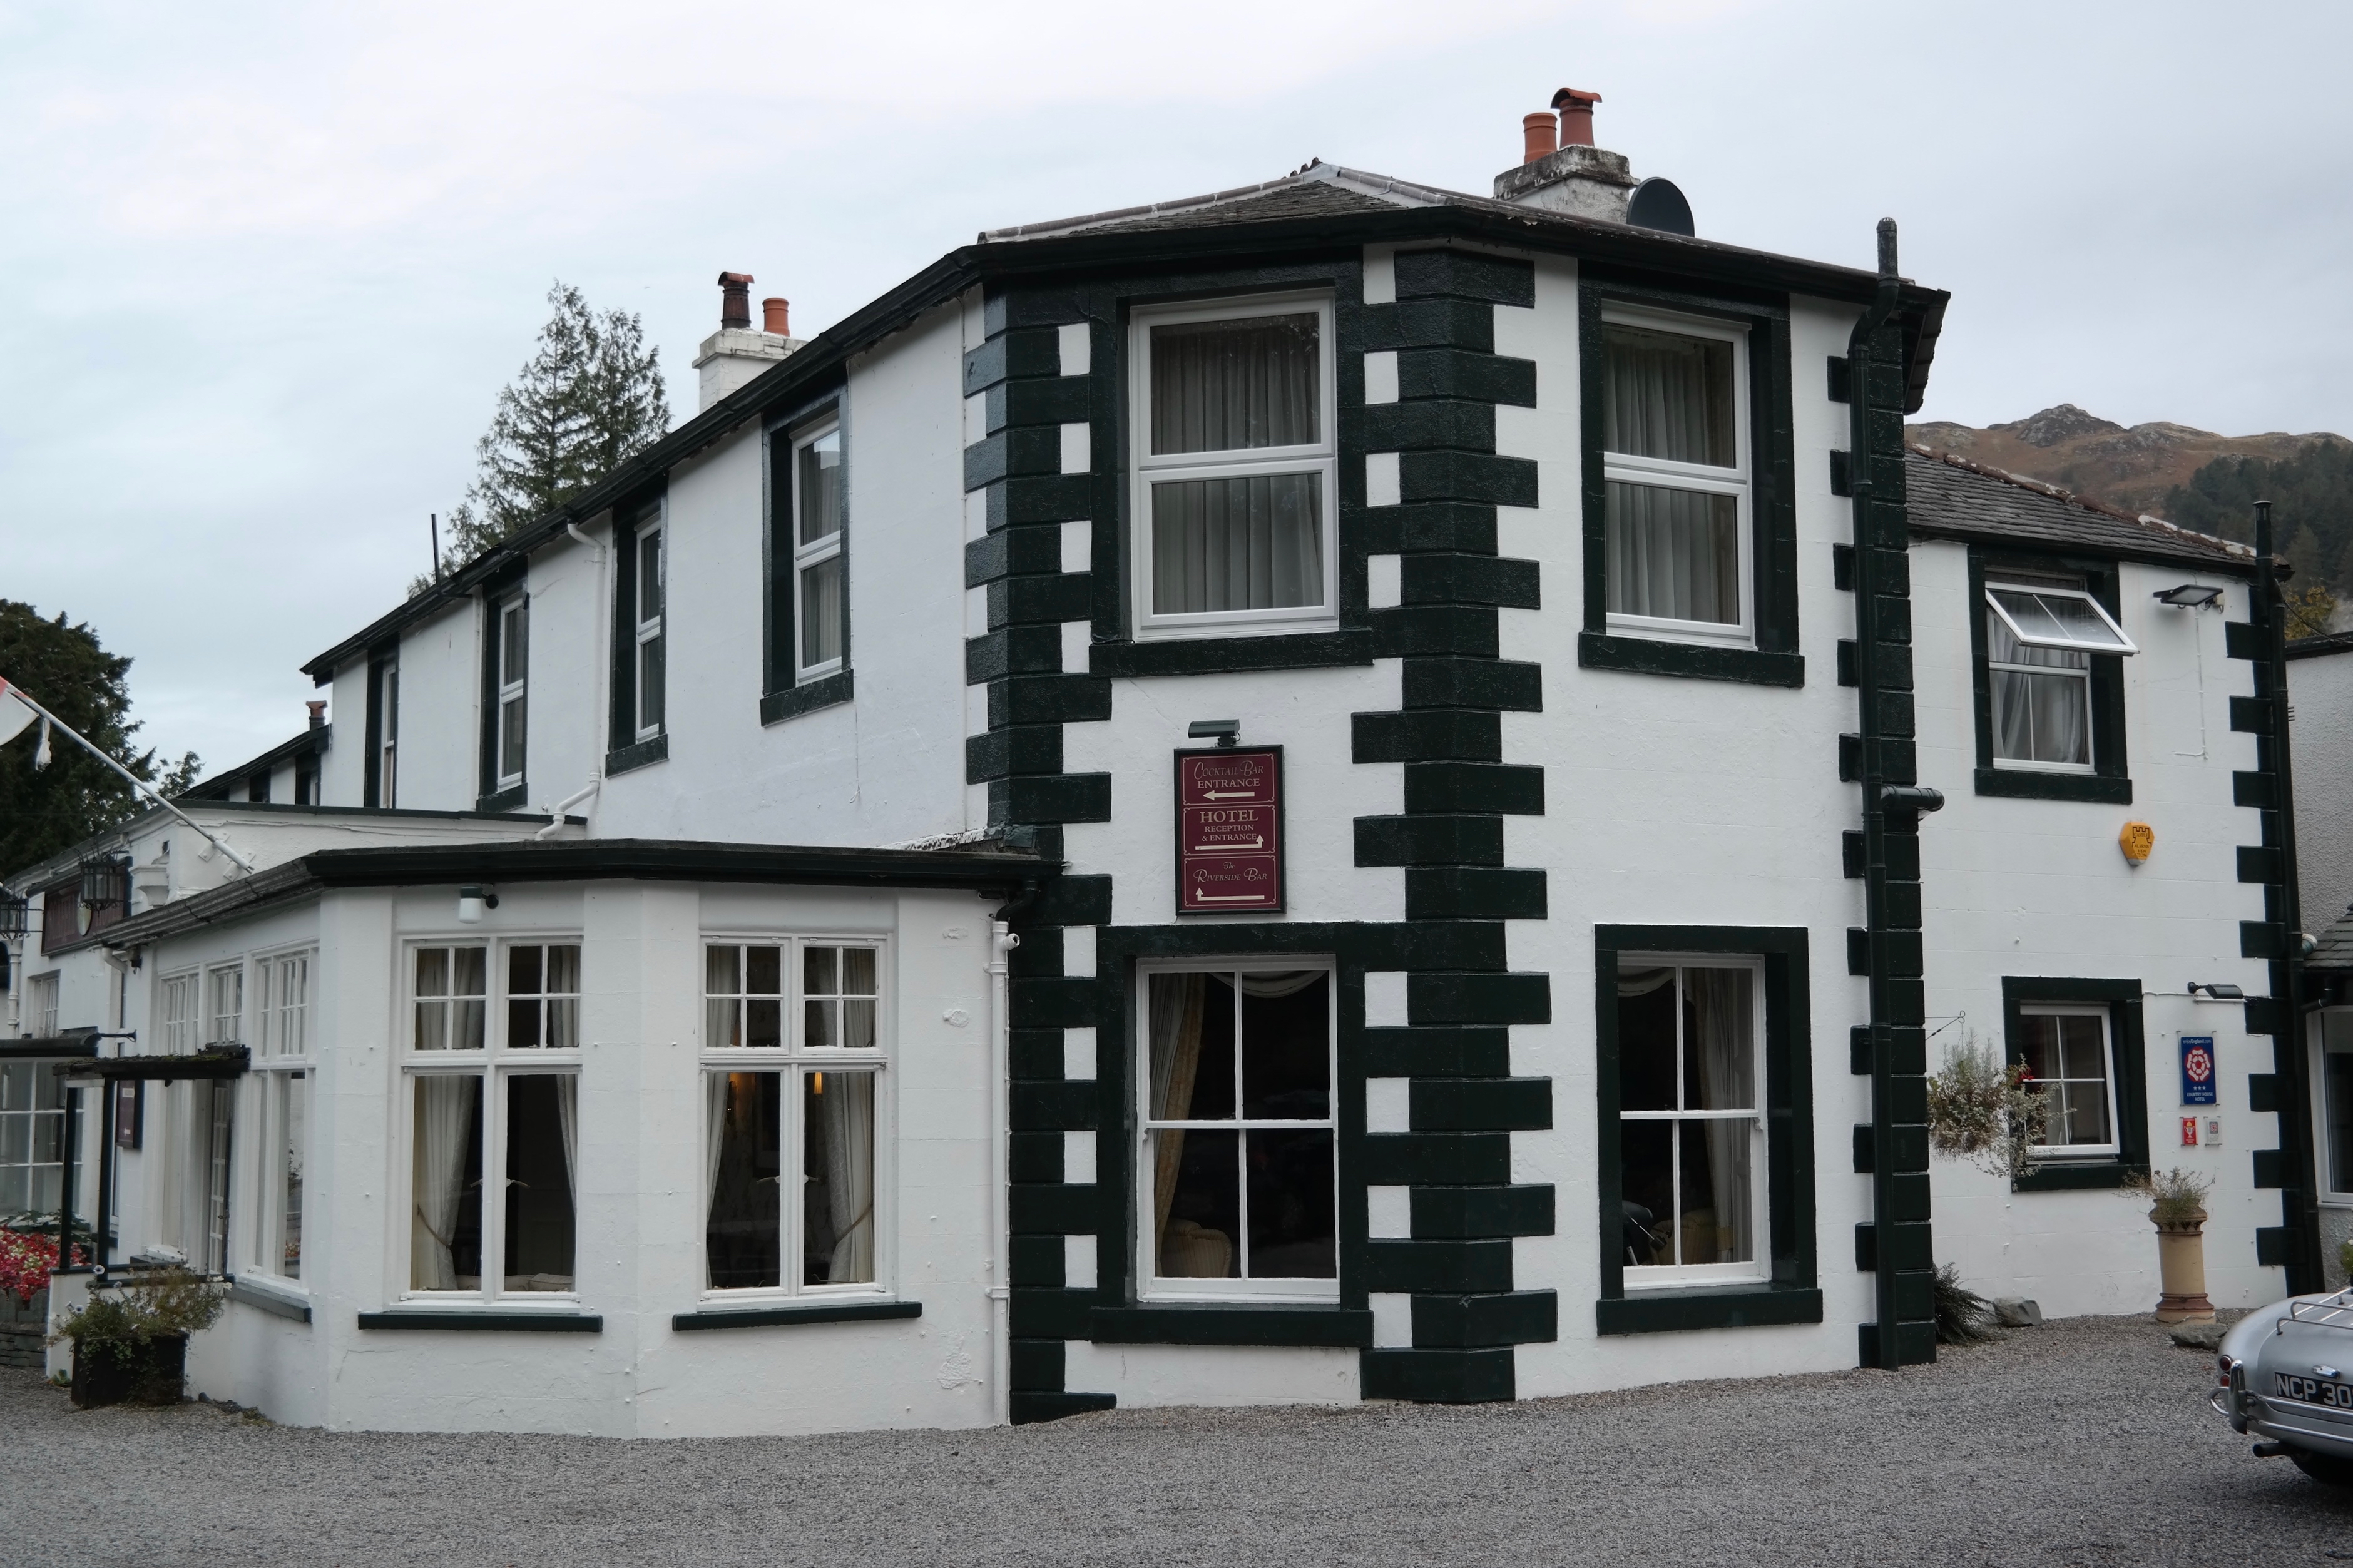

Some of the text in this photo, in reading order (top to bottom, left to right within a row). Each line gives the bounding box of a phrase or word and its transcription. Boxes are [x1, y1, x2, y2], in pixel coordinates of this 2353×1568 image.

[1197, 778, 1260, 789] ENTRANCE
[1200, 810, 1258, 823] HOTEL
[1204, 824, 1255, 833] RECEPTION
[1210, 833, 1257, 842] ENTRANCE
[1223, 862, 1235, 870] The
[2275, 1373, 2353, 1408] NCP 30
